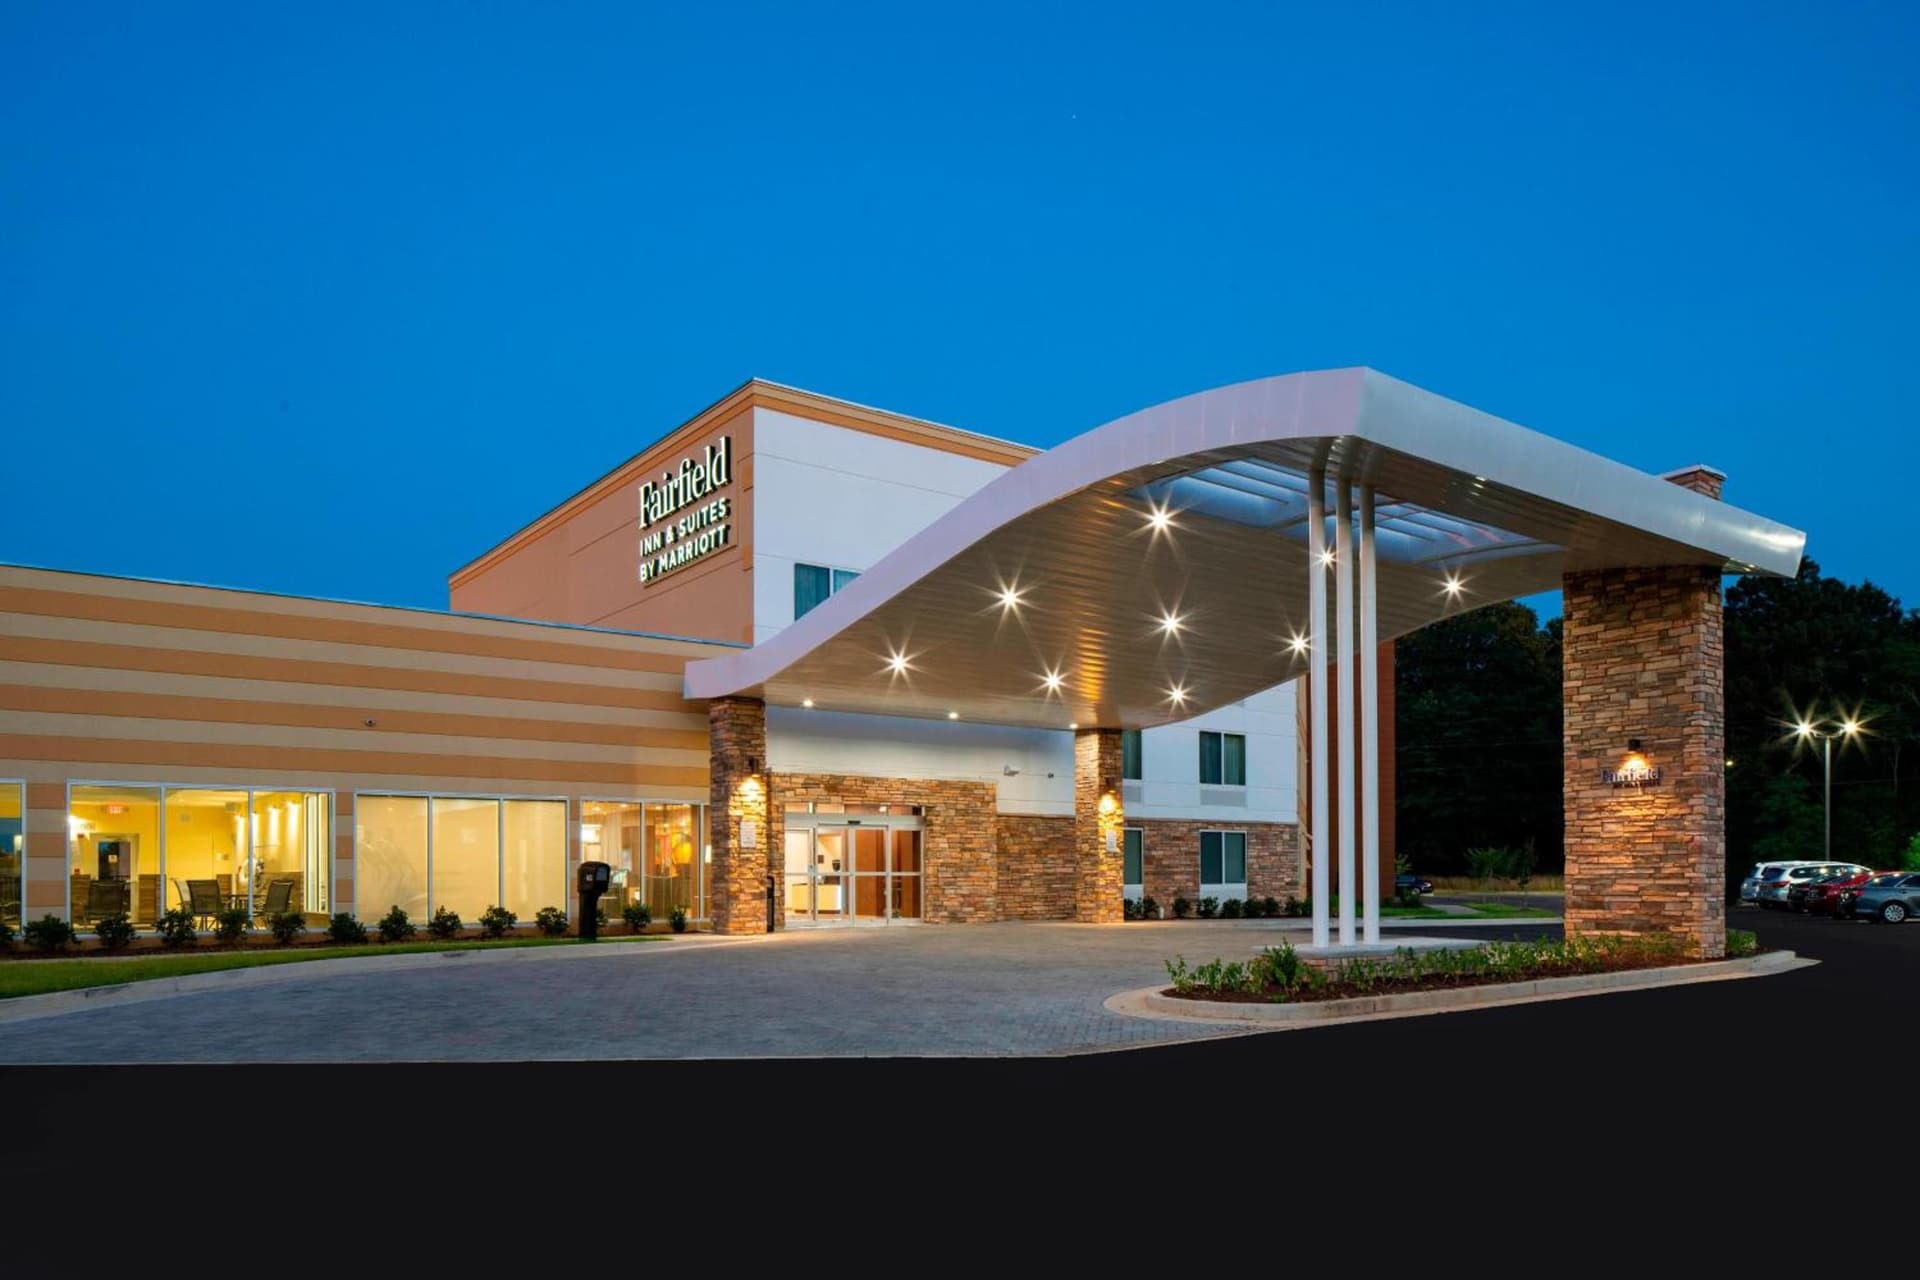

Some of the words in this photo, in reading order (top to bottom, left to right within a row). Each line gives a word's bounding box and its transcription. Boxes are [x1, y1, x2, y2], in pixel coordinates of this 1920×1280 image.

[639, 436, 732, 529] Fairfield
[640, 532, 662, 557] INN
[666, 525, 677, 545] &
[679, 497, 728, 538] SUITES
[640, 561, 655, 582] BY
[658, 525, 729, 574] MARRIOTT
